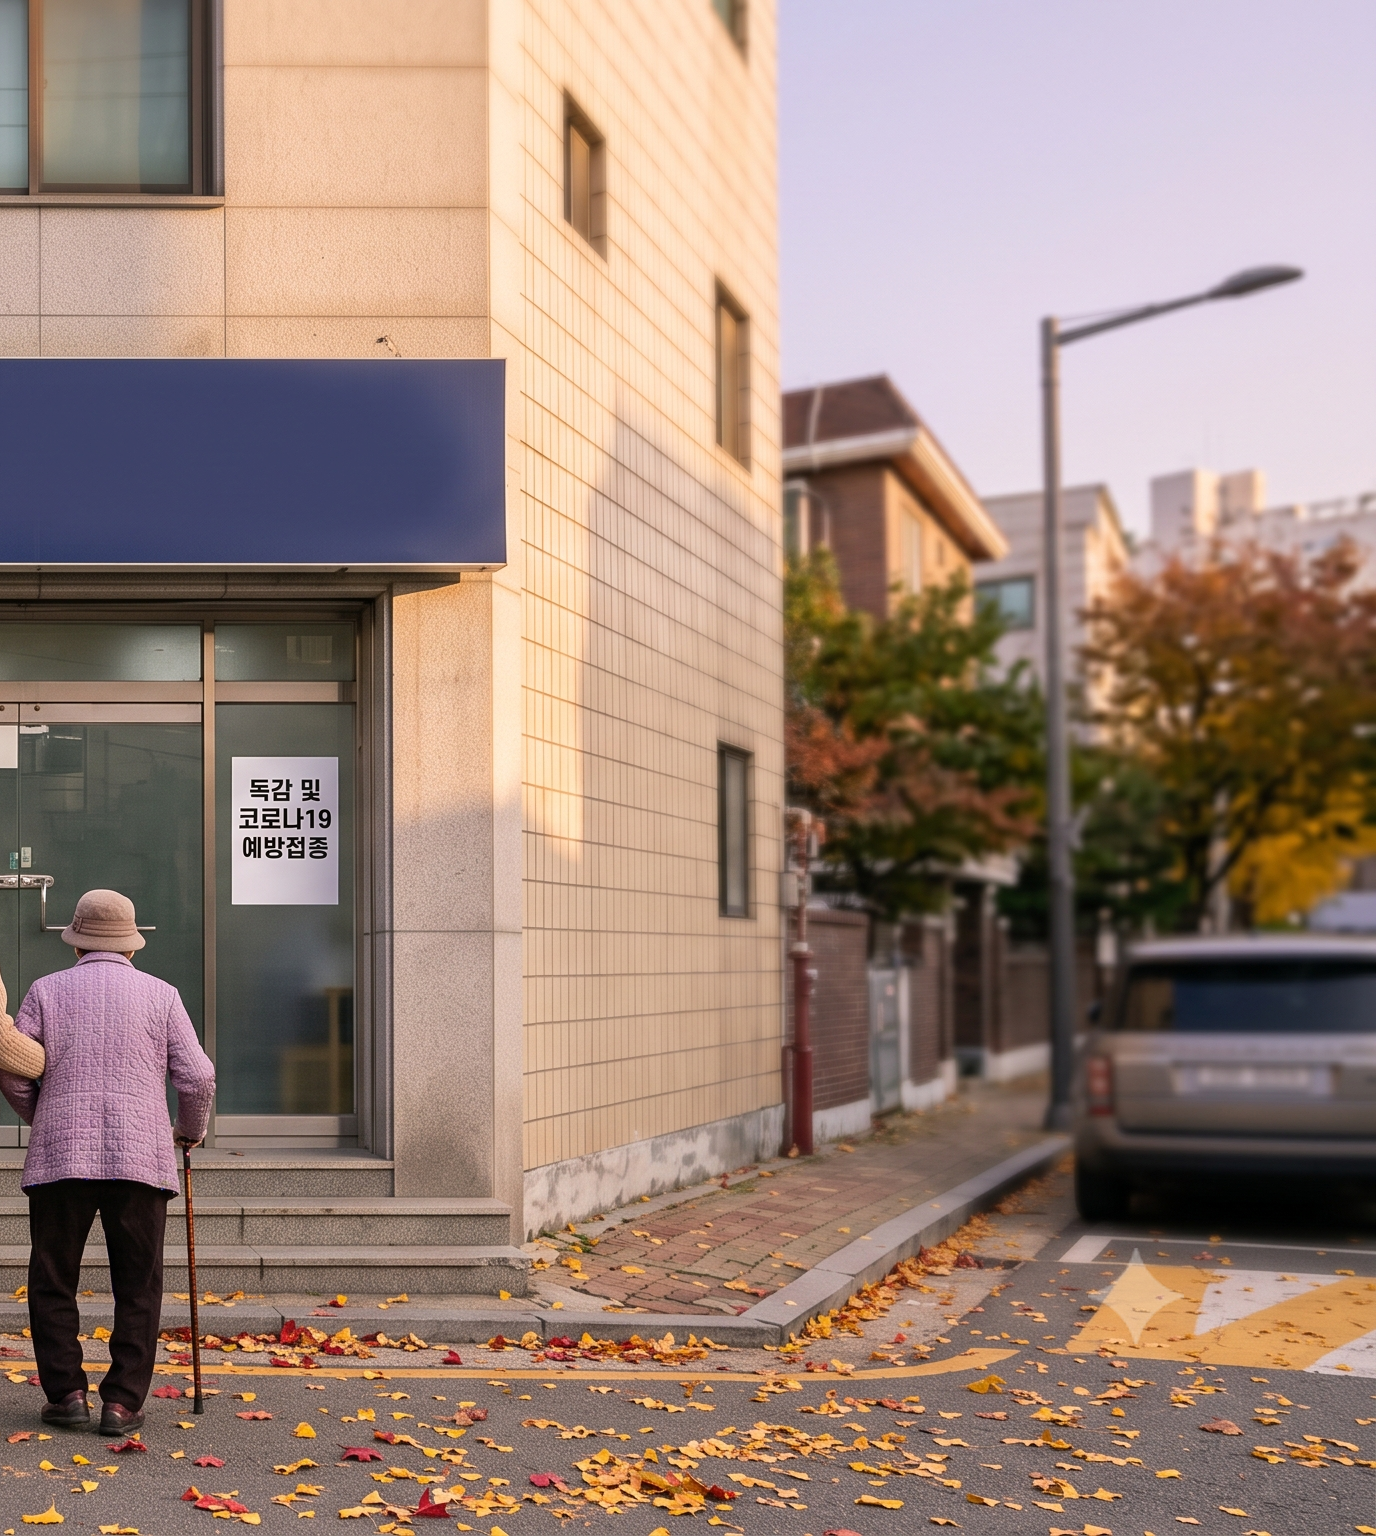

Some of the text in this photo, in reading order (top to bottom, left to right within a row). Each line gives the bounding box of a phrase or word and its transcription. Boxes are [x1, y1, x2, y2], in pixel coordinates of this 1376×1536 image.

[250, 779, 321, 801] 독감 및
[239, 808, 332, 829] 코로나19
[242, 836, 328, 859] 예방접종
